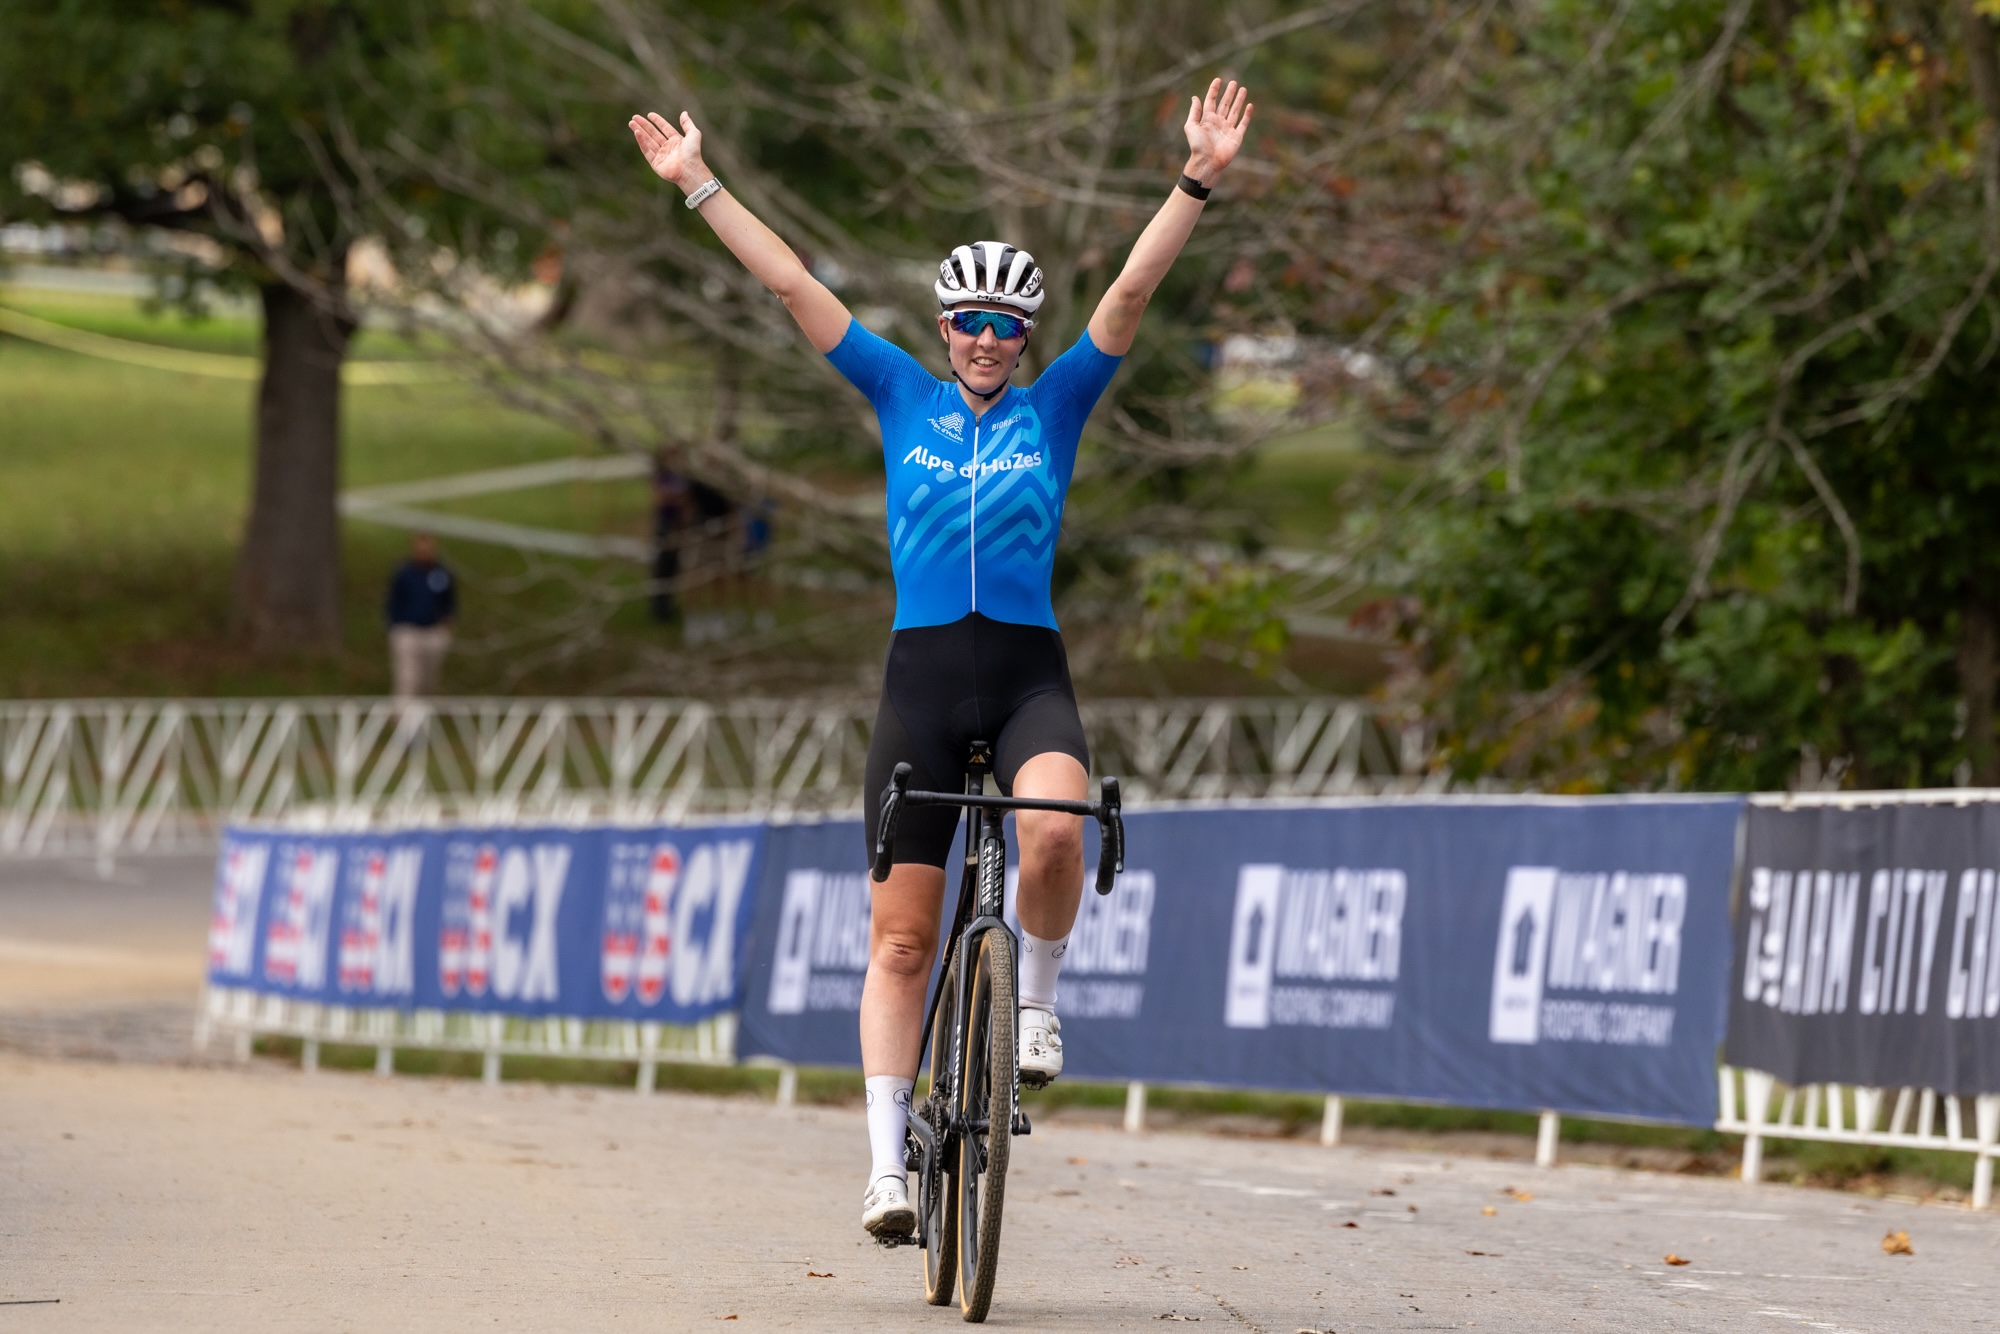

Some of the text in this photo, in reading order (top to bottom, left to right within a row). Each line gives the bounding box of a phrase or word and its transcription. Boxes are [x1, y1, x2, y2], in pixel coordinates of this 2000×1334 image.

[976, 294, 1004, 303] MET
[903, 445, 1042, 479] Alpe d'HuZes
[1858, 867, 1949, 1015] CITY
